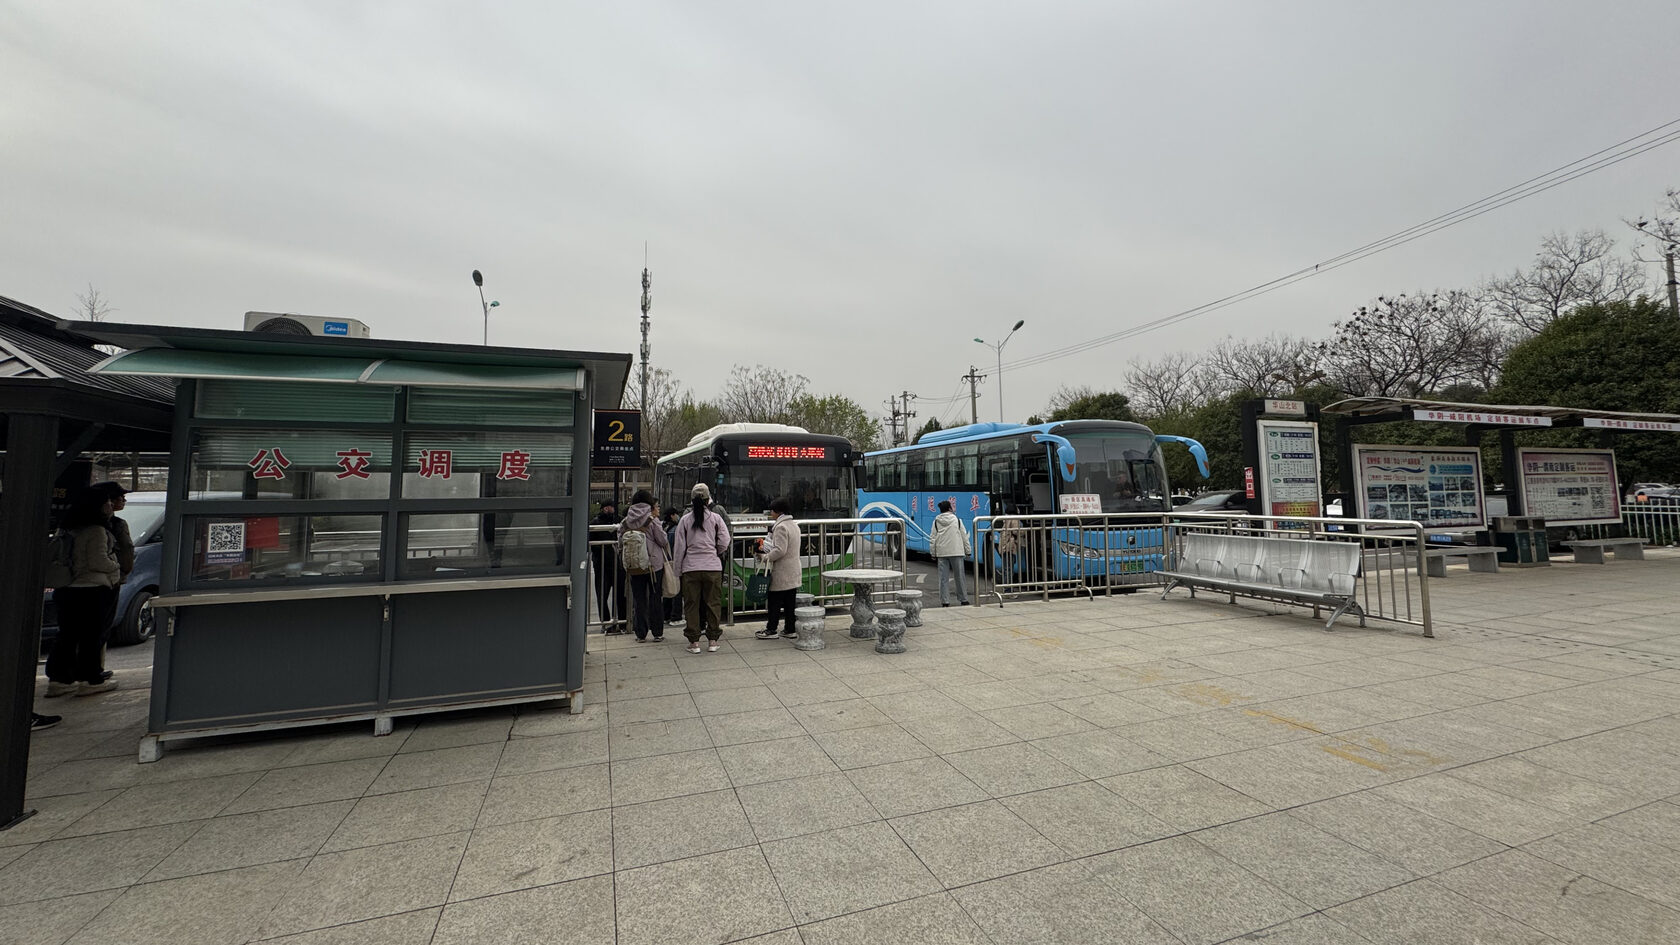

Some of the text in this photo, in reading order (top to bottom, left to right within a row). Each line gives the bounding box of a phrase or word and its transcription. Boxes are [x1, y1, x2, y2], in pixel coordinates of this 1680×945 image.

[608, 420, 633, 442] 2路
[249, 448, 531, 480] 公交调度
